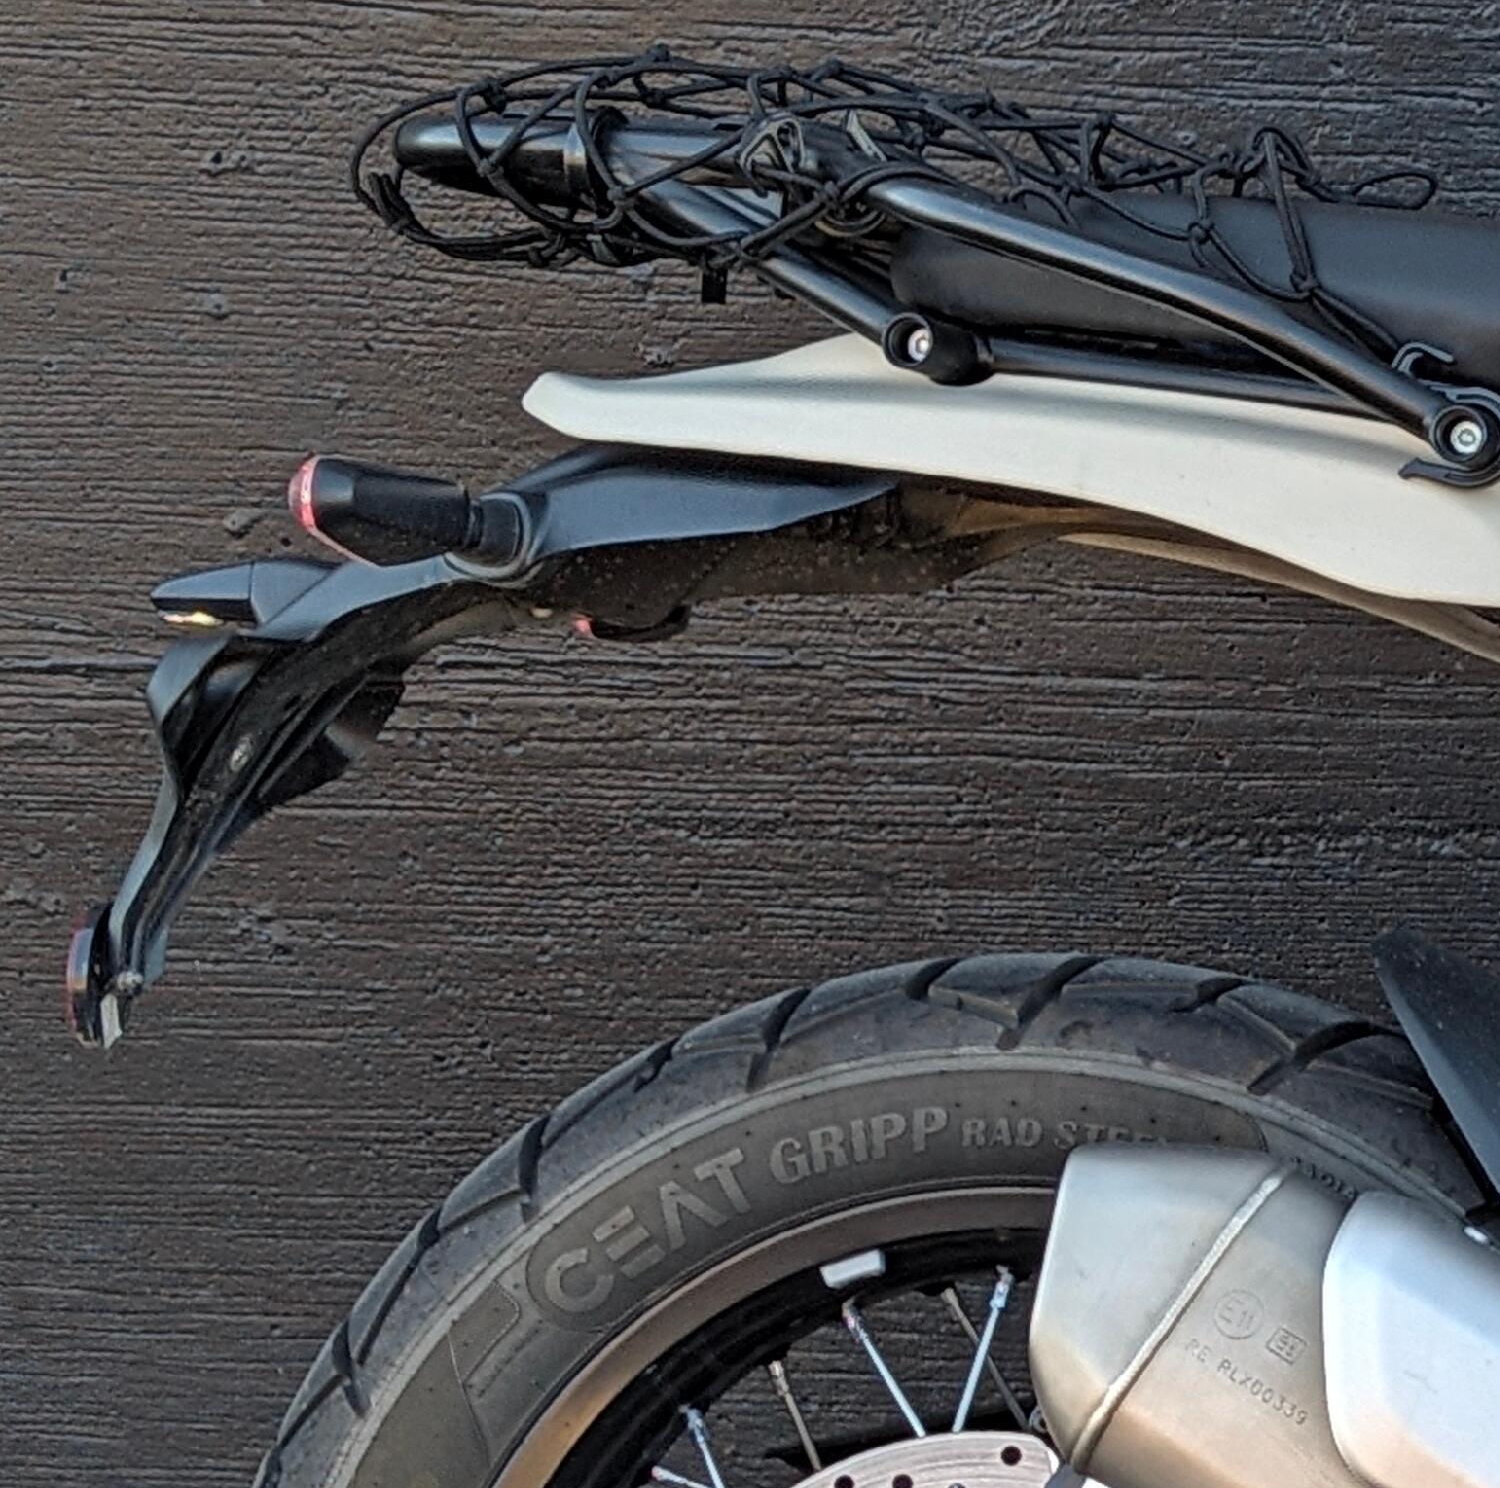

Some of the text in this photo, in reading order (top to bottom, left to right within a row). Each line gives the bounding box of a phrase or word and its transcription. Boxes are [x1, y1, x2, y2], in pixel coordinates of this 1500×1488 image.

[541, 1148, 754, 1329] CEAT
[769, 1107, 950, 1186] GRIPP
[960, 1117, 1043, 1153] RAD
